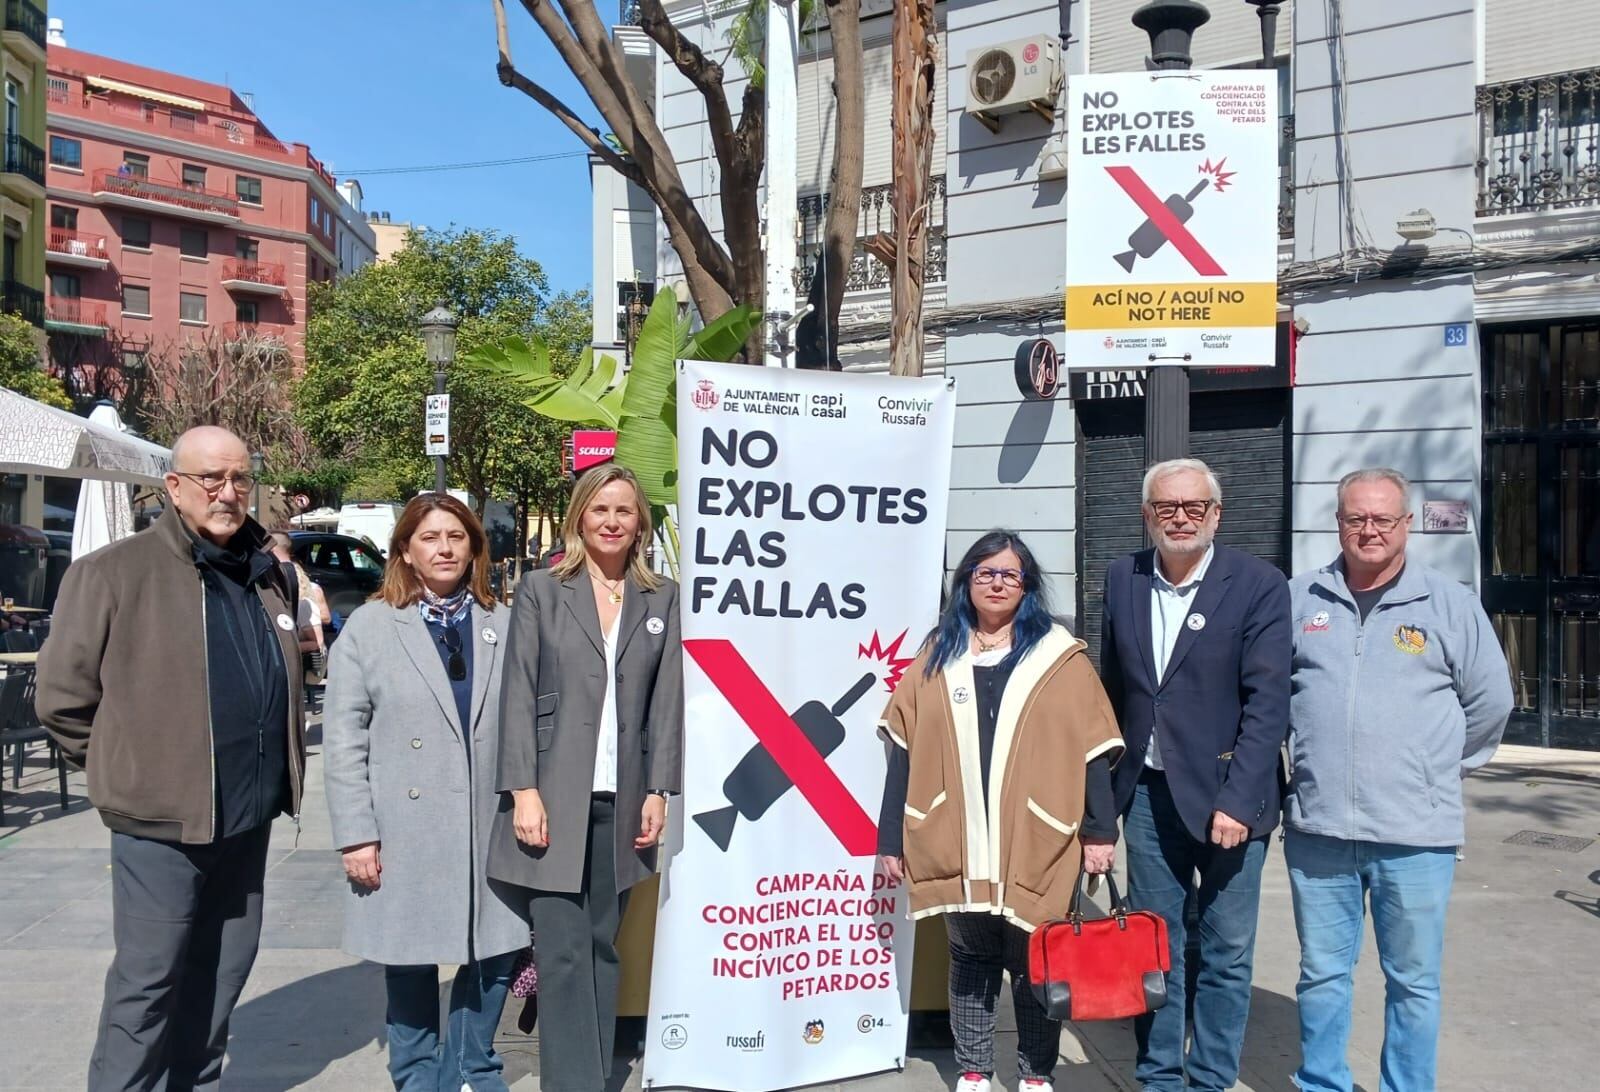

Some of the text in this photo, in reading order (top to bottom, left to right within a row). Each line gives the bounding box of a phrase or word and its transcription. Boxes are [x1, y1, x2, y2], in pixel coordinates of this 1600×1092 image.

[1024, 65, 1037, 75] LG
[1083, 91, 1118, 109] NO
[1082, 111, 1195, 132] EXPLOTES
[1082, 133, 1206, 155] LES FALLES
[1092, 289, 1122, 306] ACÍ
[1126, 291, 1153, 305] NO
[1170, 288, 1213, 304] AQUÍ
[1217, 290, 1245, 303] NO
[1128, 307, 1211, 321] NOT HERE
[1200, 333, 1233, 342] Convivir
[1447, 327, 1465, 344] 33
[724, 389, 800, 403] AJUNTAMENT
[877, 396, 933, 412] Convivir
[723, 402, 847, 418] DE VALÈNCIA casal
[881, 412, 927, 426] Russafa
[701, 426, 778, 468] NO
[697, 477, 928, 524] EXPLOTES
[694, 526, 787, 568] LAS
[691, 576, 867, 619] FALLAS
[756, 868, 865, 897] CAMPAÑA
[702, 894, 896, 925] CONCIENCIACIÓN
[723, 922, 894, 951] CONTRA EL USO
[713, 947, 892, 979] INCÍVICO DE LOS
[783, 972, 890, 1000] PETARDOS
